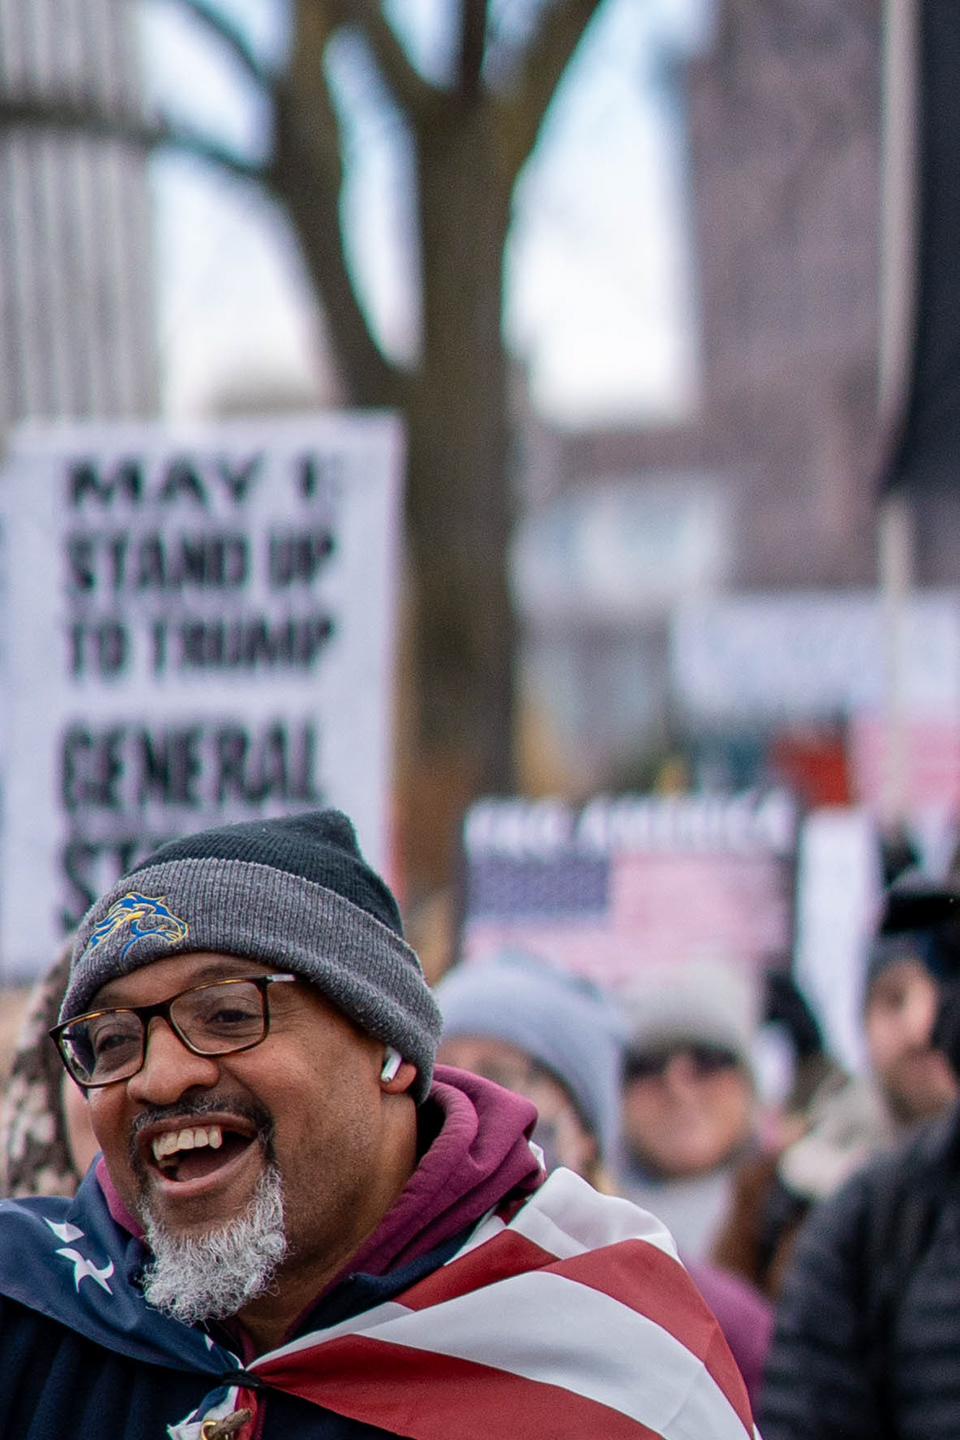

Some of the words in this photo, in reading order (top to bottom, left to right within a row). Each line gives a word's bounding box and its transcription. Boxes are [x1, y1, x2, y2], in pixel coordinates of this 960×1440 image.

[65, 452, 265, 508] MAY
[64, 528, 250, 592] STAND
[266, 526, 336, 590] UP
[66, 614, 128, 680] TO
[143, 612, 337, 680] TRUMP
[61, 718, 328, 806] GENERAL
